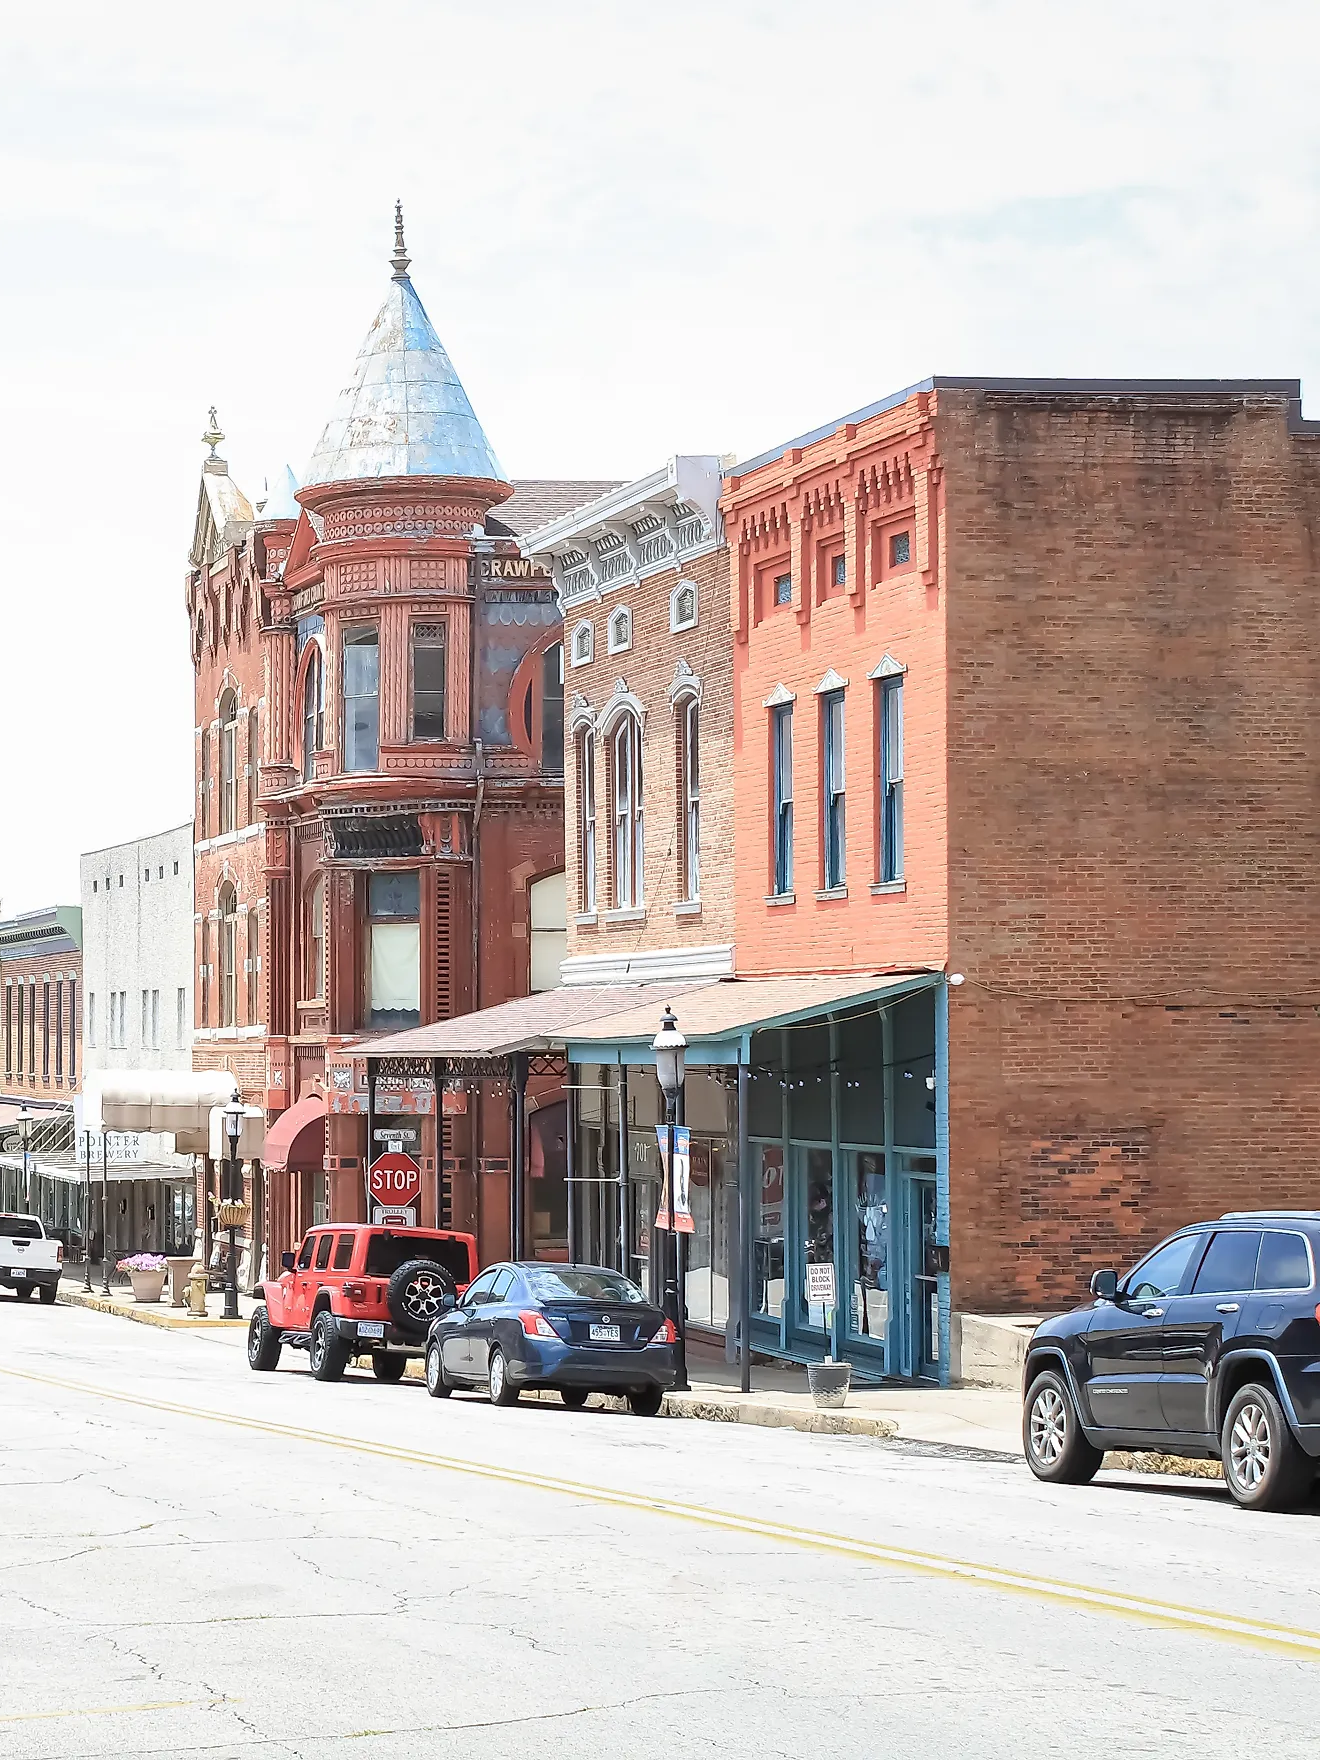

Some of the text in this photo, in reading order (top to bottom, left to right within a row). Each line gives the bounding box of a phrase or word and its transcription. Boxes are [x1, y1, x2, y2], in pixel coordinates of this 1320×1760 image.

[79, 1136, 139, 1146] POINTER
[80, 1150, 139, 1159] BREWERY
[372, 1170, 417, 1190] STOP
[606, 1329, 618, 1337] YES
